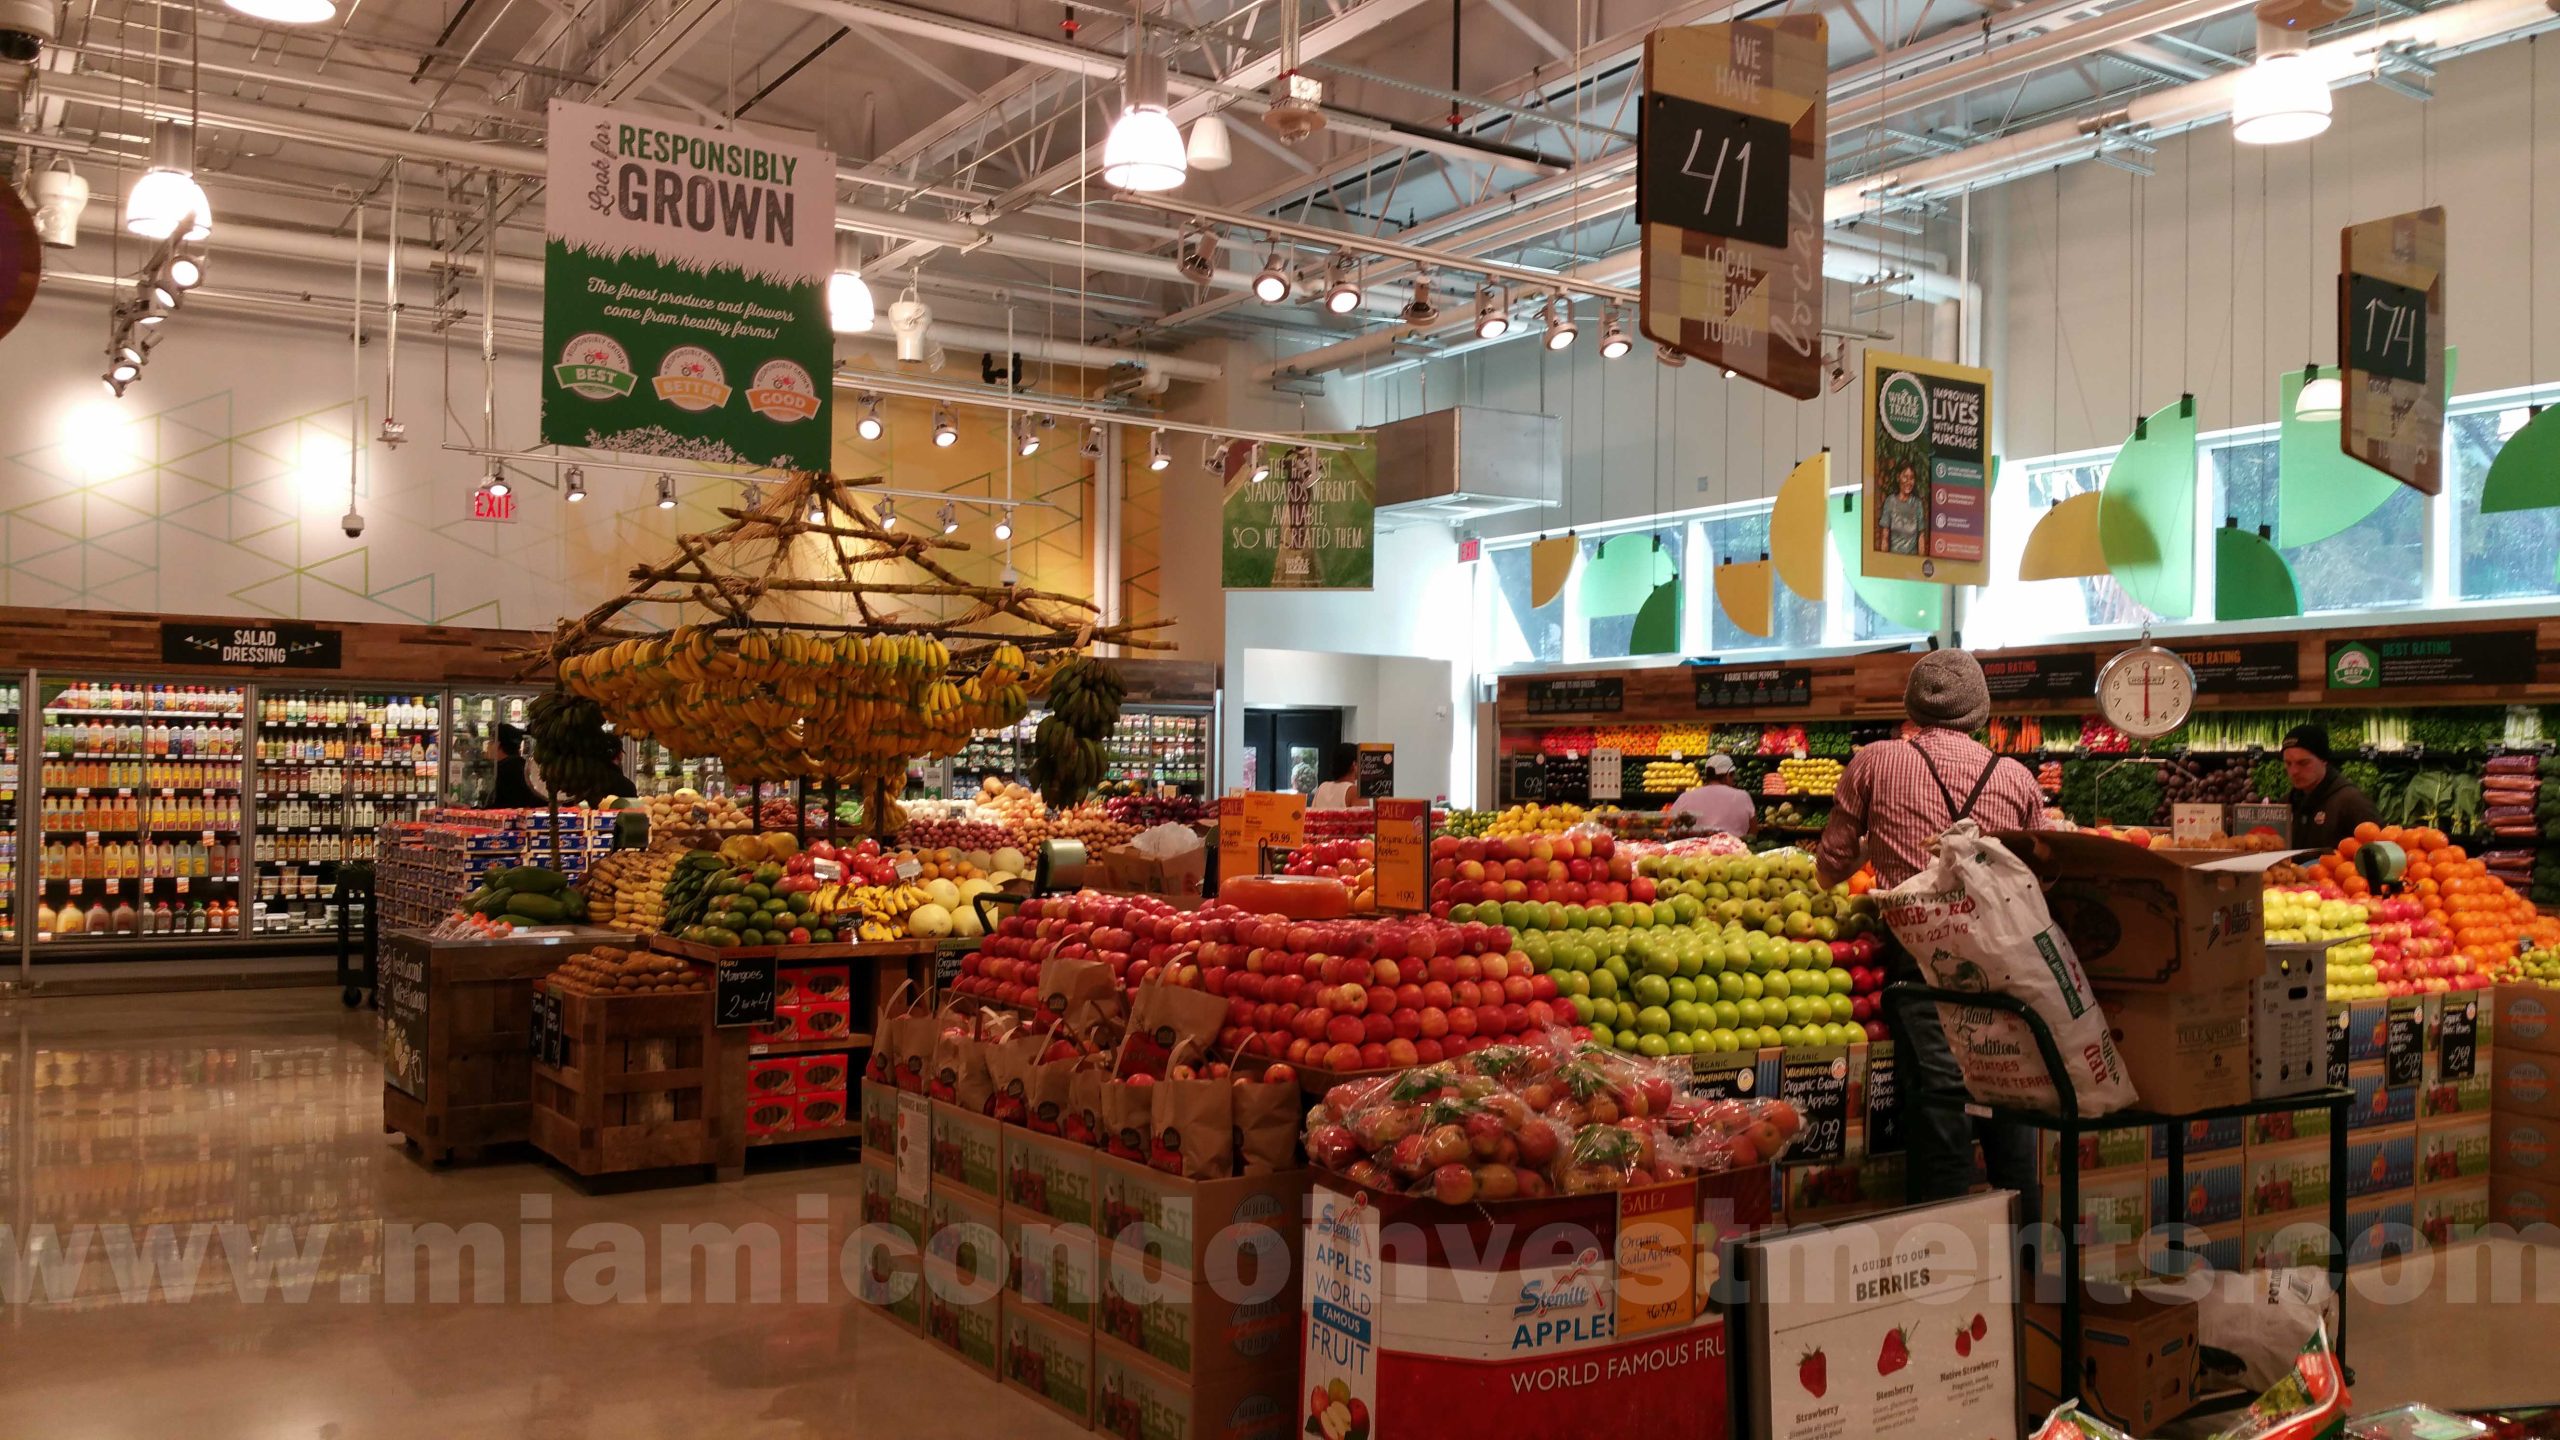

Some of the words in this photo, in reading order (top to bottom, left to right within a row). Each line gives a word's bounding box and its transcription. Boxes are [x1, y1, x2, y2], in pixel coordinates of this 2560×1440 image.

[1735, 34, 1762, 70] WE
[1715, 64, 1762, 105] HAVE
[589, 120, 620, 162] for
[618, 123, 799, 187] RESPONSIBLY
[587, 156, 617, 217] Look
[1680, 128, 1752, 227] 41
[617, 162, 796, 248] GROWN
[1704, 243, 1757, 283] LOCAL
[587, 276, 617, 296] The
[615, 282, 660, 302] finest
[657, 291, 716, 311] produce
[715, 301, 744, 316] and
[742, 301, 796, 323] flowers
[1706, 280, 1755, 313] ITEMS
[603, 304, 643, 320] come
[640, 307, 681, 326] from
[679, 314, 732, 337] healthy
[730, 321, 781, 341] farms!
[1703, 317, 1754, 349] TODAY
[2364, 297, 2417, 368] 174
[574, 367, 618, 385] BEST
[662, 380, 723, 400] BETTER
[759, 391, 807, 409] GOOD
[1933, 387, 1979, 405] IMPROVING
[1932, 398, 1979, 426] LIVES
[1933, 421, 1954, 434] WITH
[1954, 423, 1979, 437] EVERY
[1931, 431, 1979, 450] PURCHASE
[1269, 457, 1286, 480] THE
[1243, 480, 1309, 503] STANDARDS
[1312, 480, 1358, 503] WEREN'T
[475, 492, 512, 519] EXIT
[1270, 504, 1328, 527] AVAILABLE,
[1232, 527, 1260, 549] SO
[1265, 527, 1281, 549] WE
[1283, 527, 1331, 549] CREATED
[1334, 527, 1365, 549] THEM.
[1461, 540, 1478, 561] EXIT
[233, 629, 277, 646] SALAD
[2382, 642, 2409, 657] BEST
[2411, 640, 2451, 656] RATING
[222, 645, 287, 664] DRESSING
[2141, 660, 2150, 671] 0
[2205, 649, 2242, 665] RATING
[2006, 659, 2037, 674] RATING
[2124, 666, 2132, 676] 9
[2113, 680, 2120, 690] 8
[2172, 679, 2179, 690] 2
[2114, 697, 2121, 708] 7
[2172, 697, 2180, 708] 3
[2125, 711, 2132, 722] 6
[2160, 711, 2168, 721] 4
[1377, 803, 1405, 818] SALE!
[1269, 832, 1291, 844] $9.99
[1378, 835, 1403, 850] Organic
[720, 969, 764, 983] Mangoes
[724, 994, 741, 1018] 2
[1695, 1060, 1728, 1069] ORGANIC
[1785, 1053, 1819, 1062] ORGANIC
[2083, 1044, 2108, 1086] RED
[1694, 1070, 1738, 1083] WASHINGTON
[1785, 1066, 1832, 1079] WASHINGTON
[1693, 1085, 1726, 1100] Organic
[1784, 1079, 1816, 1094] Organic
[1807, 1093, 1840, 1109] Apples
[961, 1134, 997, 1170] BEST
[2456, 1136, 2489, 1155] BEST
[1044, 1164, 1089, 1202] BEST
[2291, 1164, 2330, 1187] BEST
[1242, 1198, 1280, 1217] WHOLE
[1621, 1192, 1665, 1214] SALE!
[2095, 1196, 2143, 1221] BEST
[1142, 1199, 1192, 1240] BEST
[1317, 1203, 1361, 1247] Stemilt
[1621, 1234, 1661, 1251] Organic
[1316, 1243, 1372, 1284] APPLES
[1851, 1263, 1859, 1275] A
[1861, 1255, 1893, 1273] GUIDE
[1895, 1252, 1909, 1265] TO
[1910, 1247, 1931, 1262] OUR
[1316, 1271, 1372, 1315] WORLD
[1855, 1267, 1932, 1302] BERRIES
[1511, 1278, 1589, 1319] Stemilt
[1142, 1299, 1188, 1340] BEST
[1321, 1304, 1361, 1334] FAMOUS
[1311, 1322, 1370, 1375] FRUIT
[1043, 1341, 1086, 1384] BEST
[1510, 1361, 1601, 1396] WORLD
[1606, 1342, 1689, 1381] FAMOUS
[1940, 1369, 1961, 1383] Native
[1962, 1359, 2000, 1377] Strawberry
[1875, 1383, 1915, 1402] Stemberry
[1139, 1392, 1187, 1440] BEST
[1795, 1404, 1840, 1425] Strawberry
